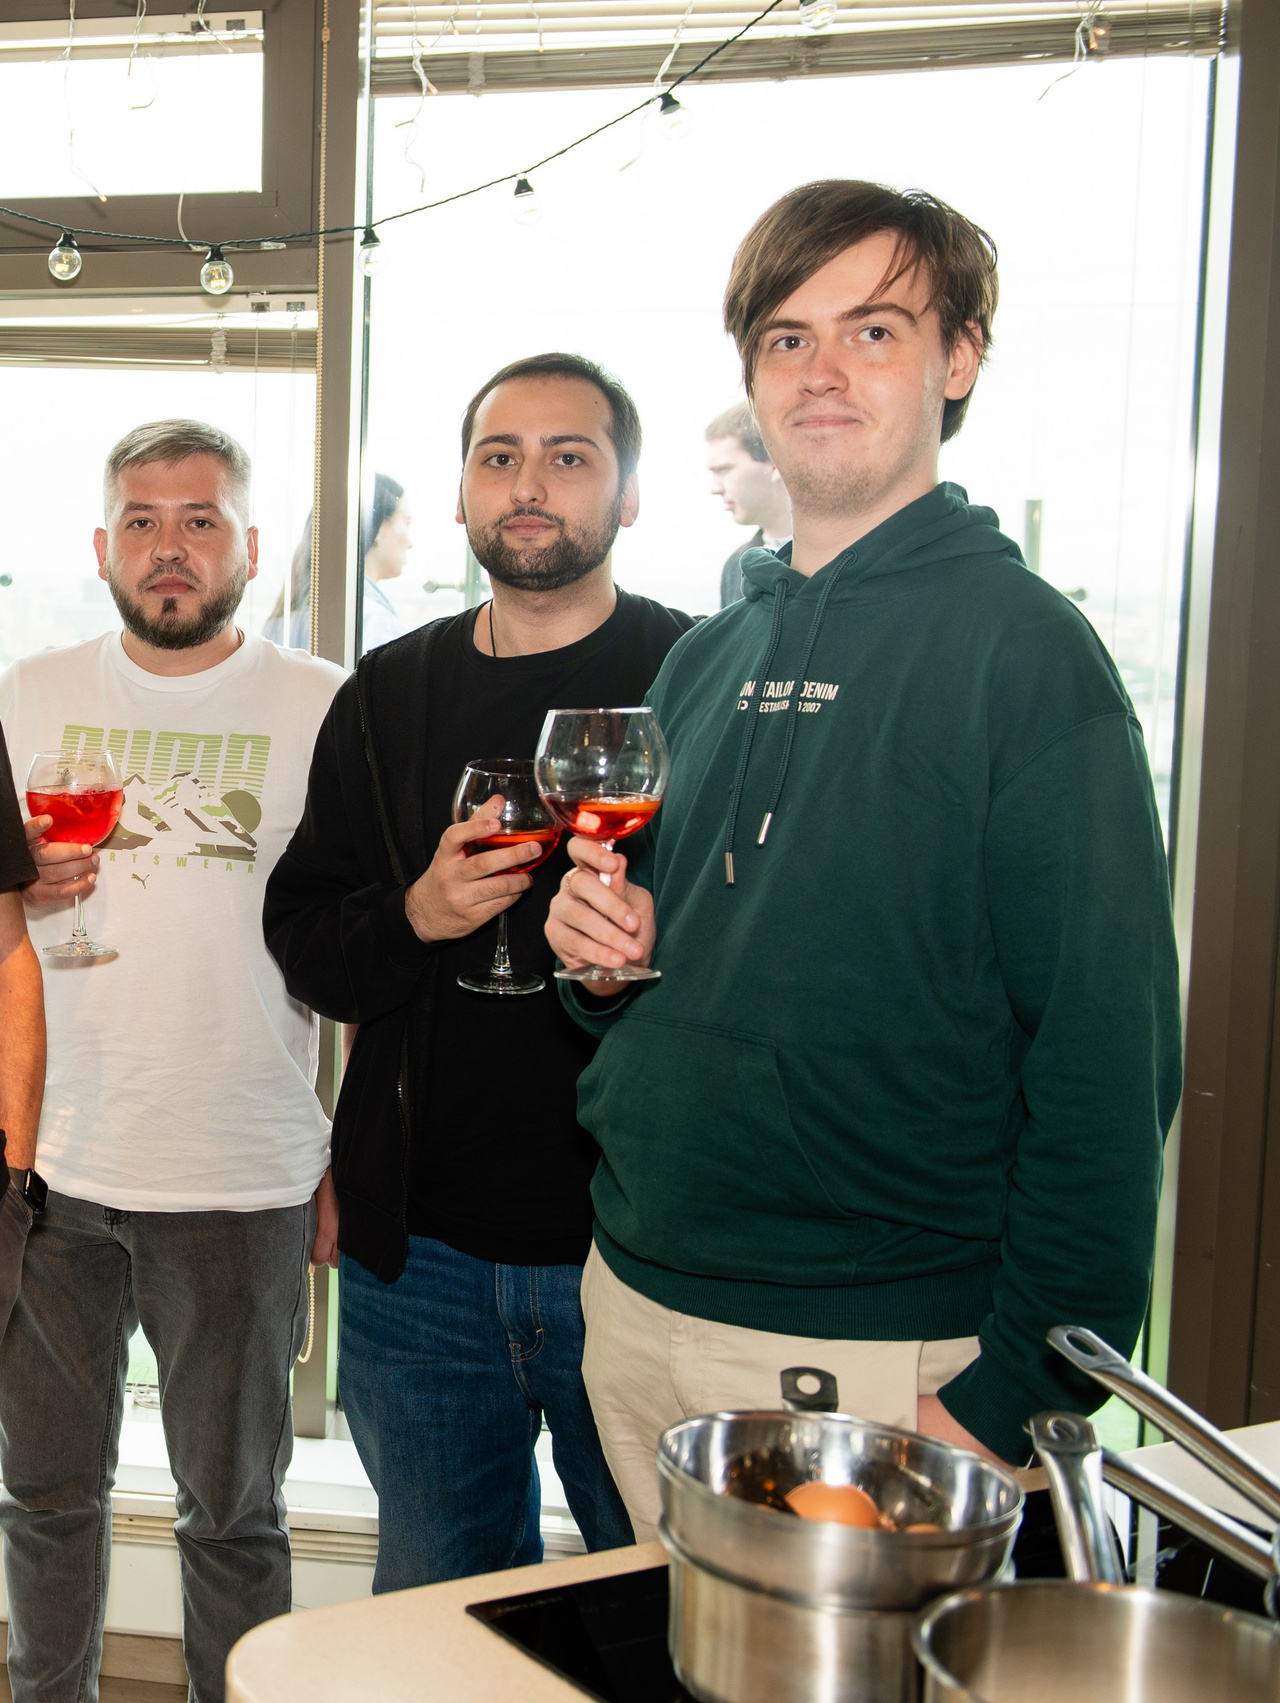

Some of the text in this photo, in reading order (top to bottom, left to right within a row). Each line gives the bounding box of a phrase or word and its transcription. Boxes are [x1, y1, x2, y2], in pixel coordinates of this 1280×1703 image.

[800, 681, 839, 700] DENIM
[802, 702, 822, 713] 2007
[109, 851, 254, 874] RTSWEAR
